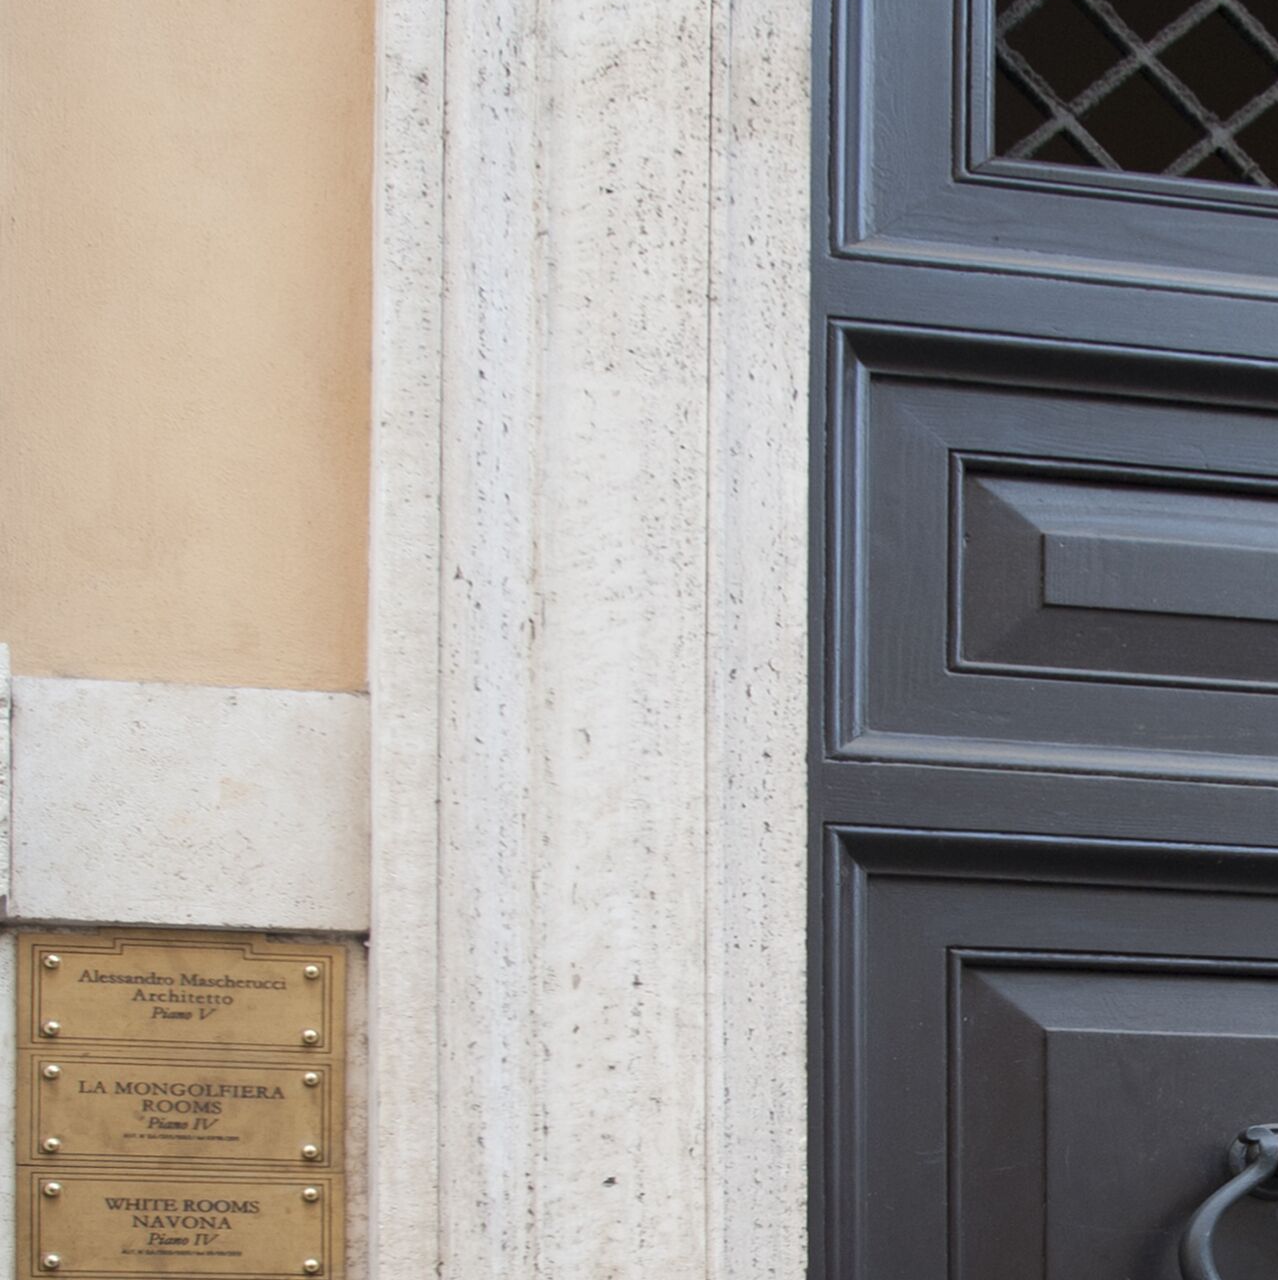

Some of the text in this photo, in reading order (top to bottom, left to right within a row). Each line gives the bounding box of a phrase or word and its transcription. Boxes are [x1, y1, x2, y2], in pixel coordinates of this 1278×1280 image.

[78, 969, 287, 990] Alessandro Mascherucci
[132, 988, 234, 1005] Architetto
[151, 1006, 217, 1020] Piano V
[78, 1080, 285, 1099] LA MONGOLFIERA
[142, 1099, 223, 1115] ROOMS
[147, 1116, 219, 1130] Piano IV
[104, 1197, 260, 1214] WHITE ROOMS
[132, 1215, 232, 1230] NAVONA
[147, 1232, 220, 1246] Piano IV
